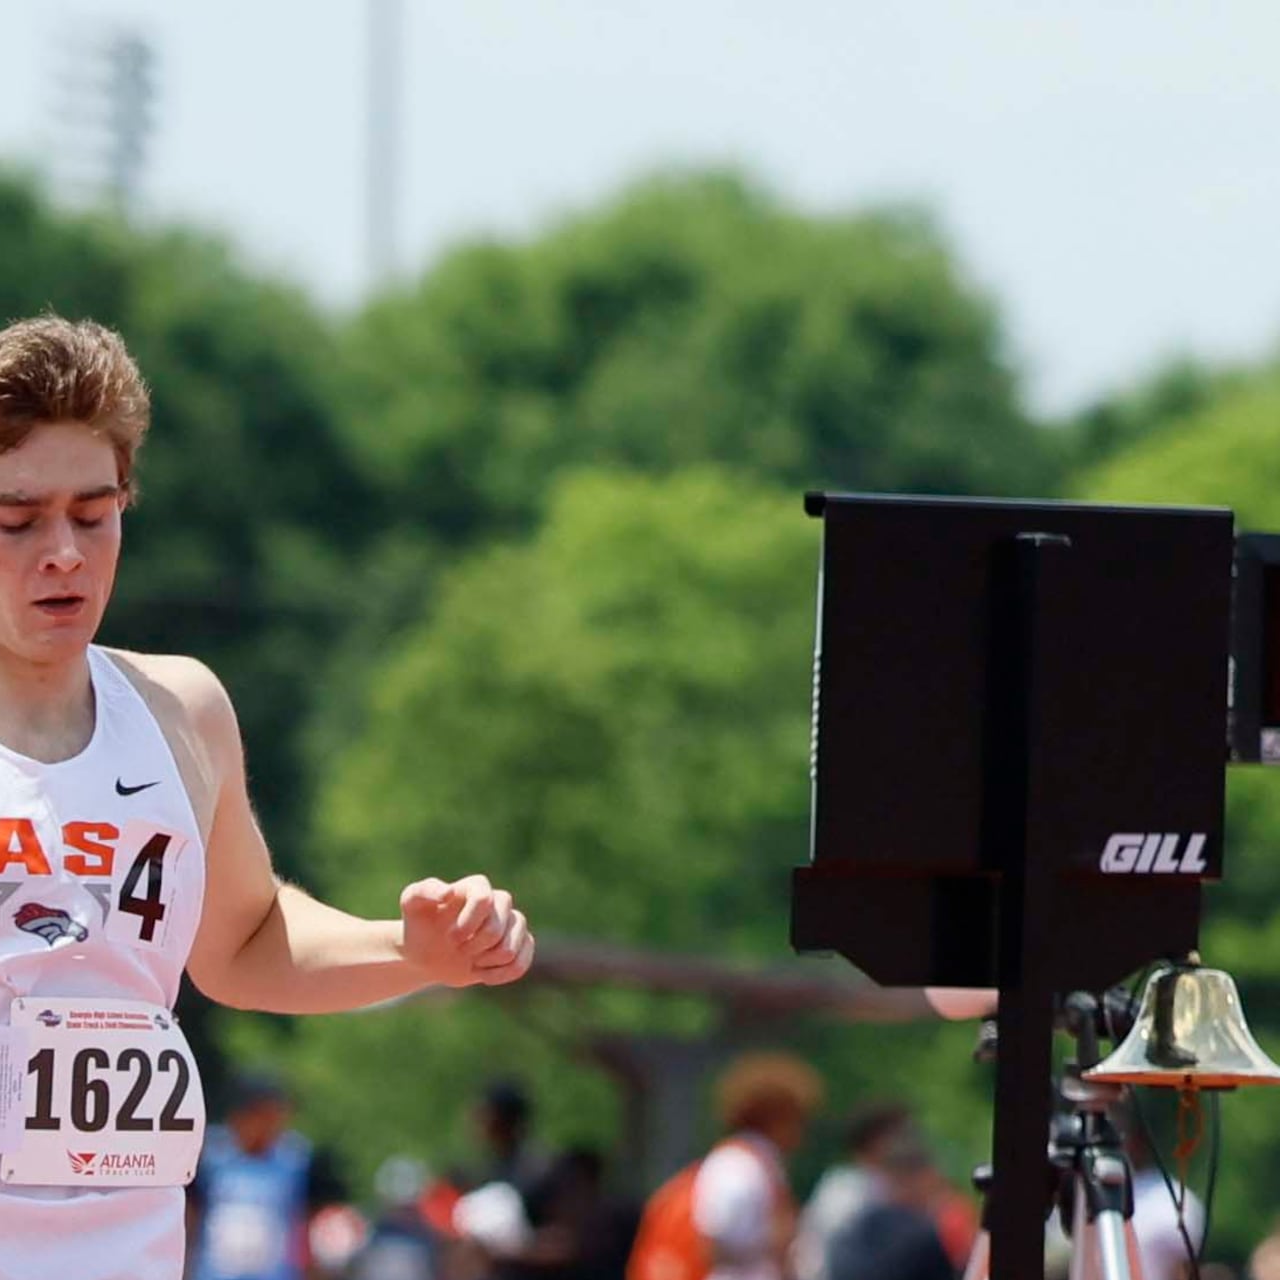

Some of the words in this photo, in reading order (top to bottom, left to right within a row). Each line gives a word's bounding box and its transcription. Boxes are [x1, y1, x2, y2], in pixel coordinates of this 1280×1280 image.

[1100, 832, 1207, 874] GILL
[118, 832, 173, 943] 4
[25, 1047, 195, 1133] 1622
[100, 1153, 155, 1168] ATLANTA
